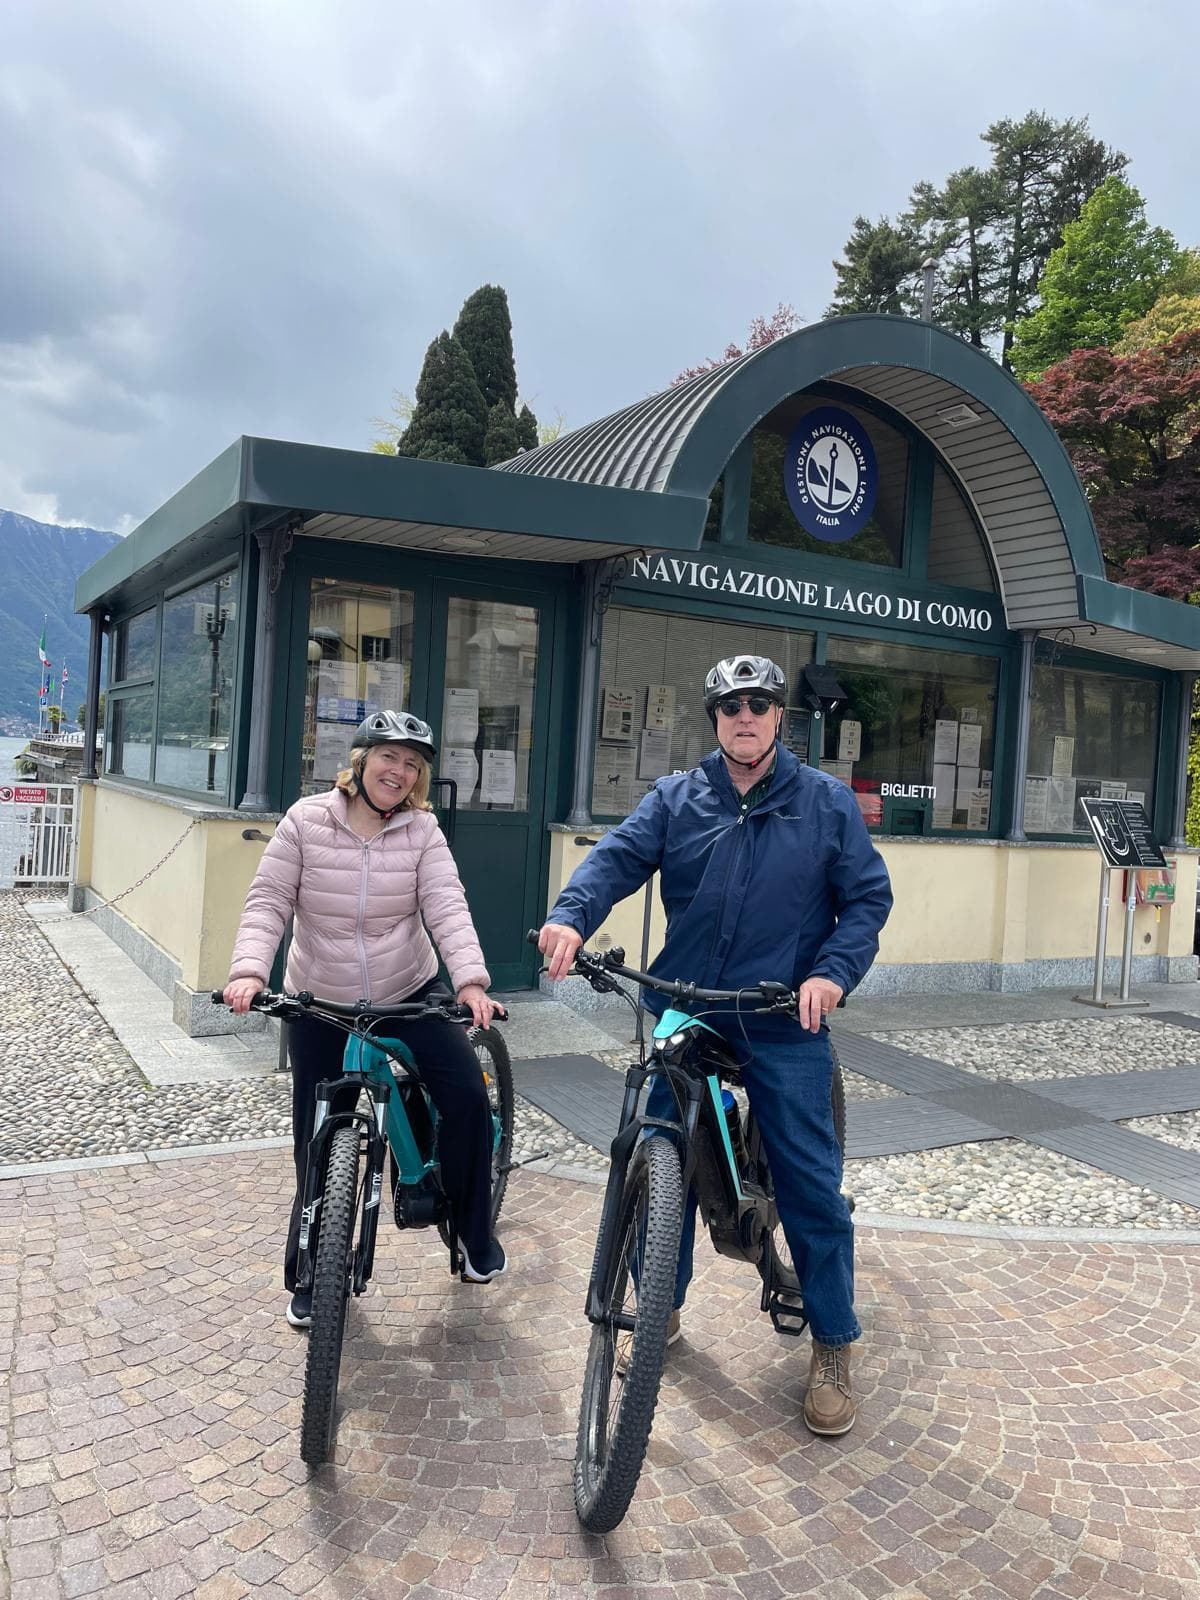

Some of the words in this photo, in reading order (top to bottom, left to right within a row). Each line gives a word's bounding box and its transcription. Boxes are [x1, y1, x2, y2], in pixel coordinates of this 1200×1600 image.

[797, 441, 810, 504] GESTIONE
[812, 425, 866, 471] NAVIGAZIONE
[851, 482, 866, 515] LAGHI
[816, 514, 840, 526] ITALIA
[630, 555, 819, 606] NAVIGAZIONE
[823, 585, 892, 618] LAGO
[896, 597, 921, 622] DI
[926, 602, 993, 632] COMO
[881, 782, 937, 800] BIGLIETTI
